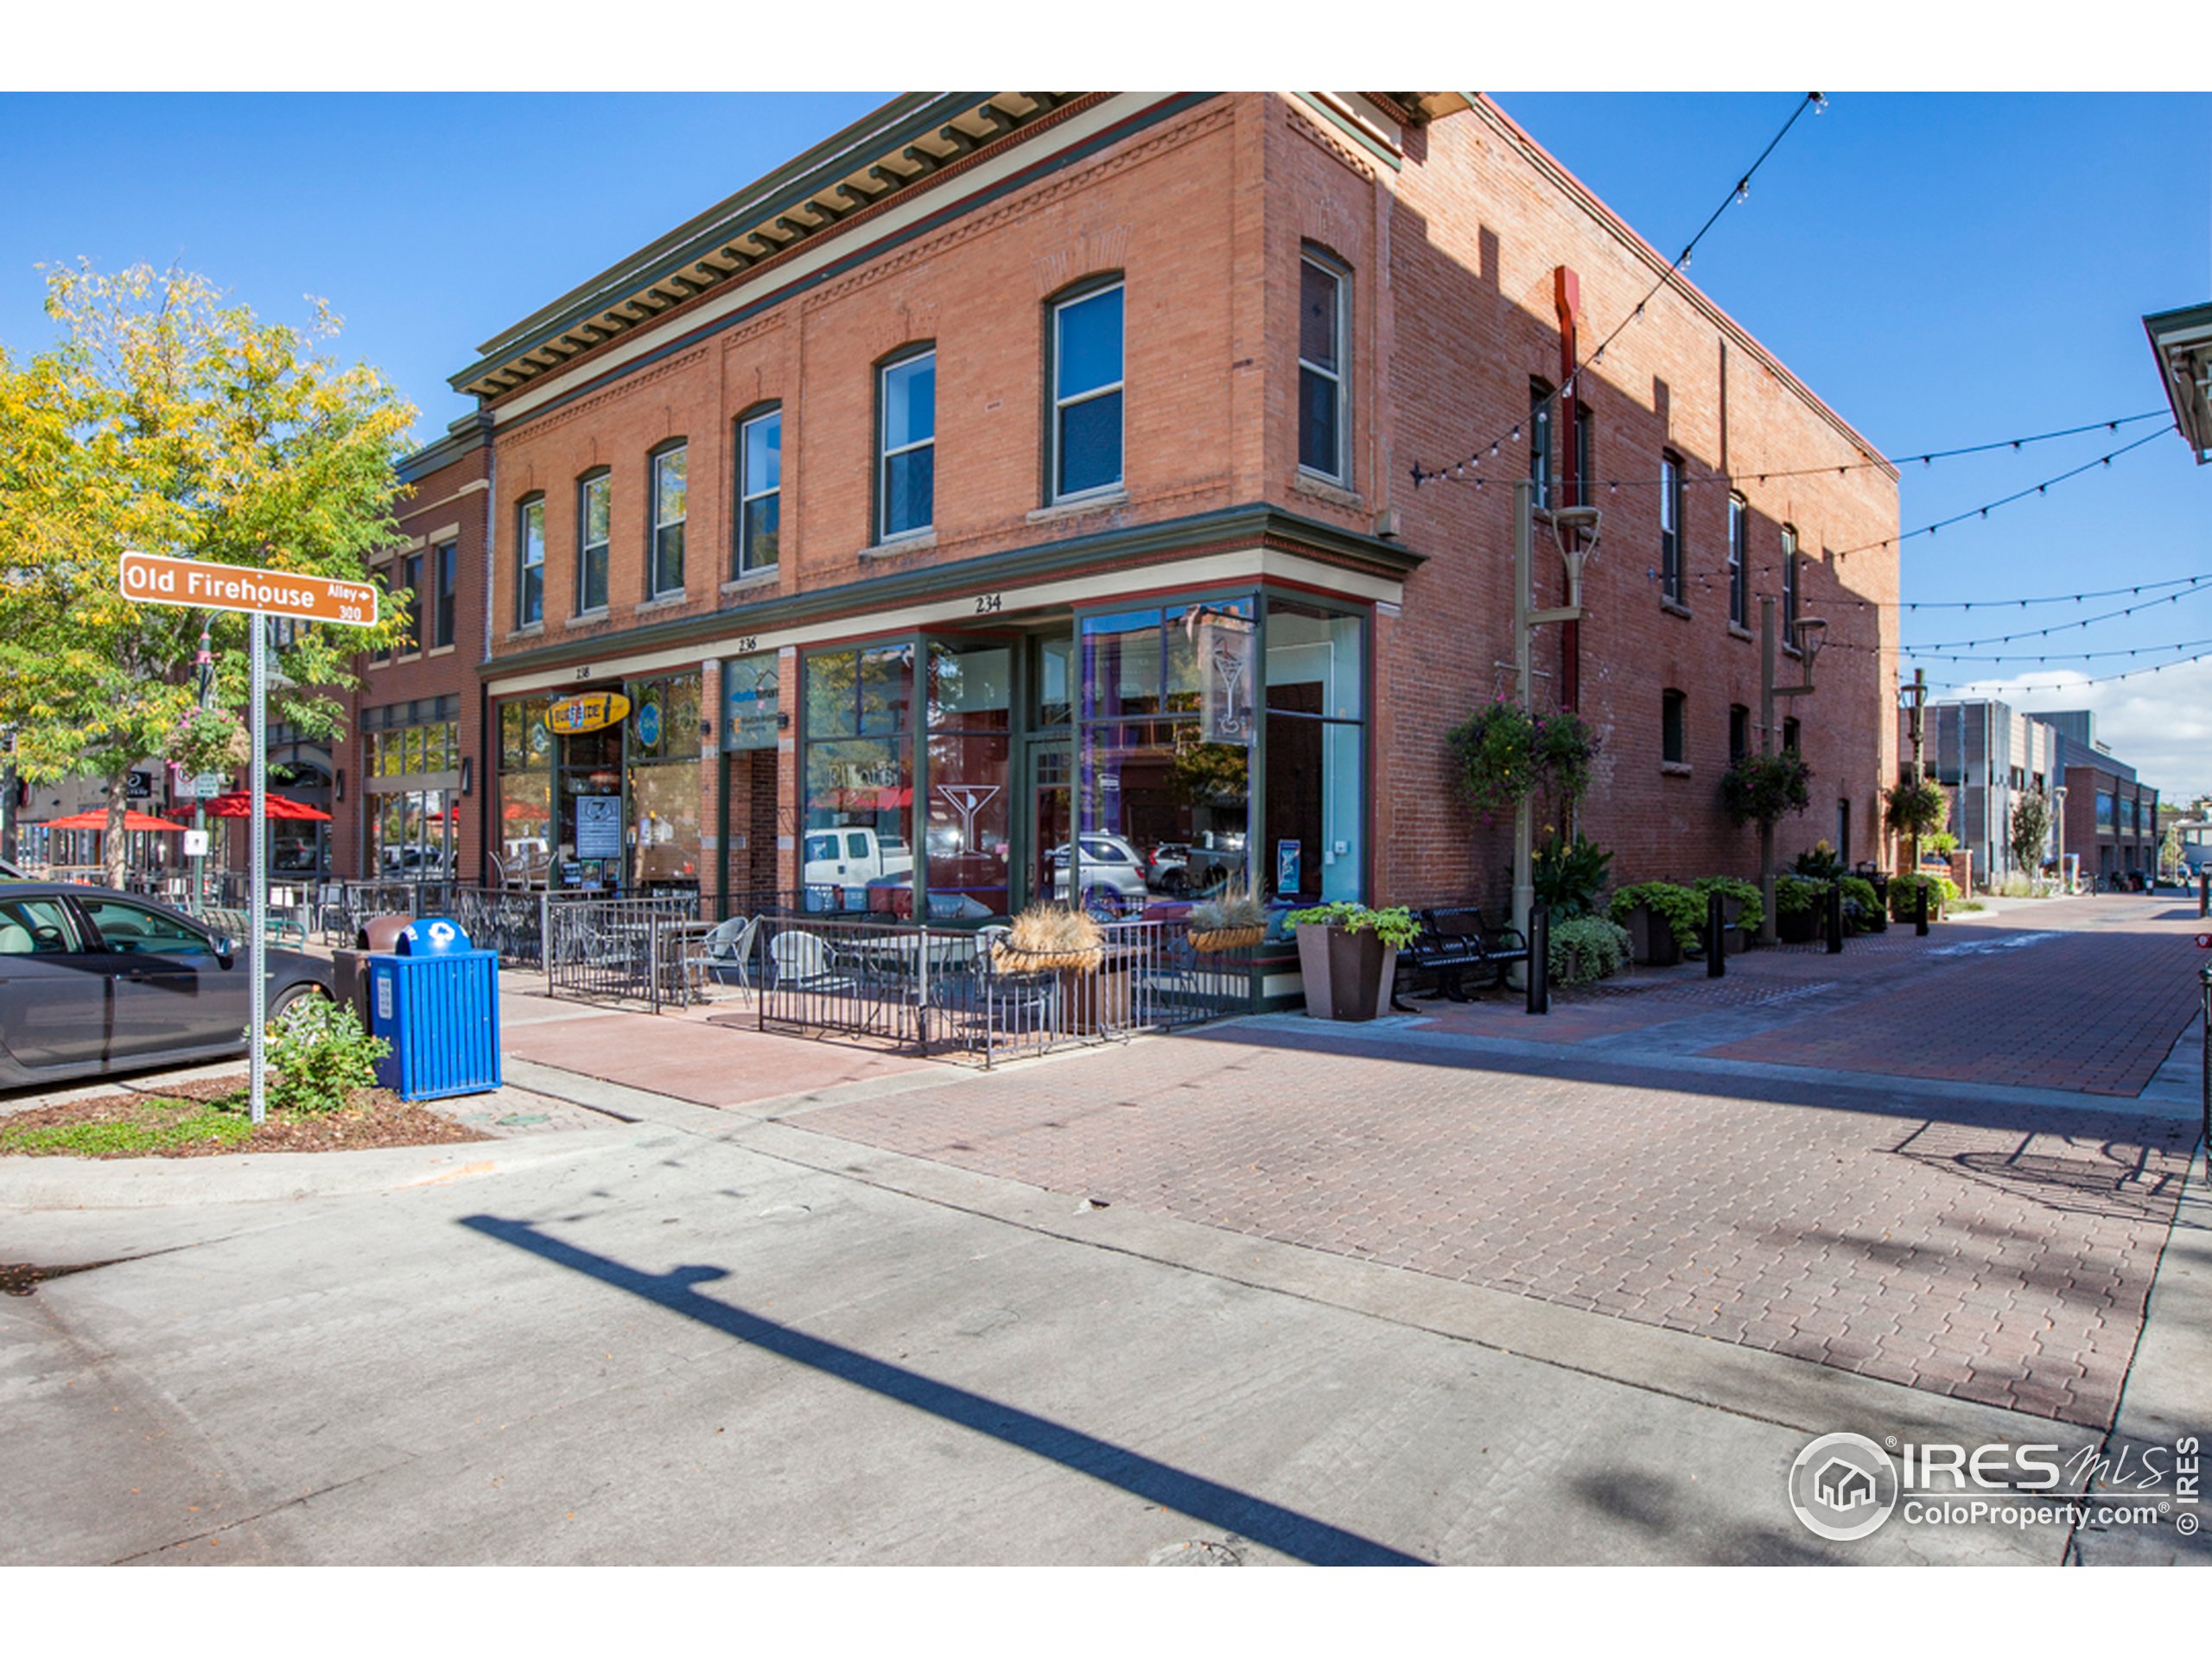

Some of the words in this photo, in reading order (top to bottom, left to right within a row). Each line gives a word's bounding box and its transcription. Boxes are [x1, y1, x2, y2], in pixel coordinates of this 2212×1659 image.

[129, 565, 174, 592] Old
[188, 572, 315, 608] Firehouse
[327, 583, 357, 603] Alley
[339, 604, 362, 621] 300
[976, 594, 1001, 613] 234
[739, 636, 756, 652] 236
